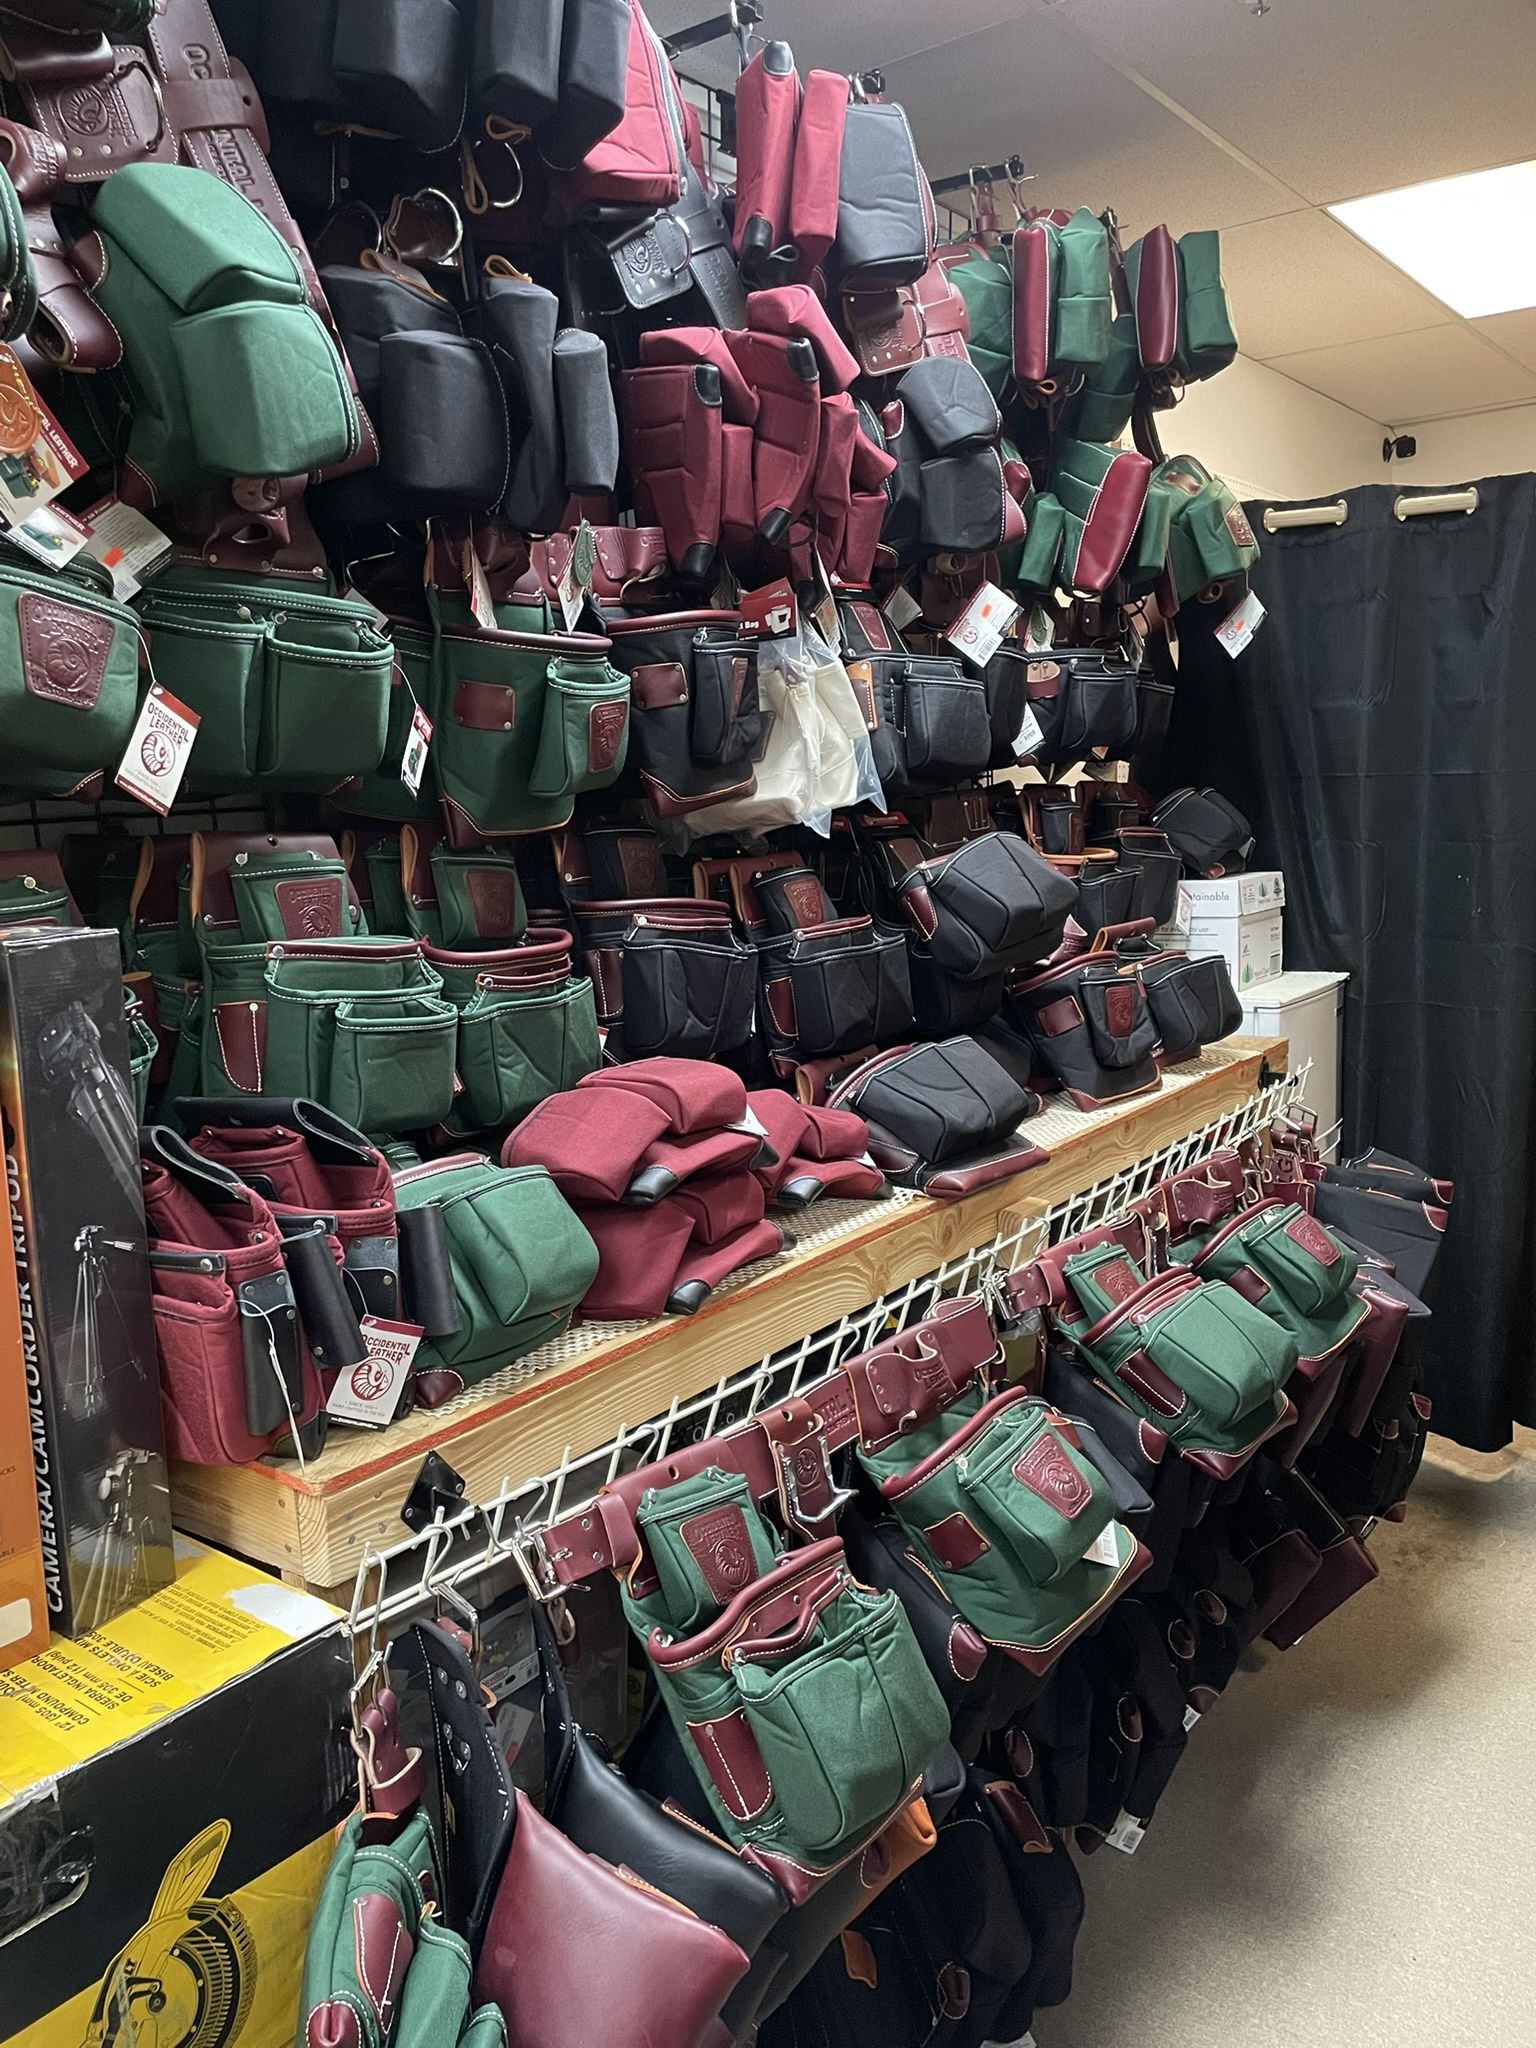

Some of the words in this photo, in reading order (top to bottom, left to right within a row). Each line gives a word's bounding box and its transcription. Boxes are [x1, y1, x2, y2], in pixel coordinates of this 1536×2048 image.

[50, 430, 79, 469] LEATHER
[148, 702, 189, 743] OCCIDENTAL
[150, 716, 182, 750] LEATHER
[369, 1347, 404, 1366] EATHER
[30, 1656, 88, 1690] INGLETADOR
[135, 1673, 162, 1688] SCIE
[140, 1662, 175, 1681] BISEAU
[37, 1692, 90, 1725] COMPOUND
[83, 1688, 120, 1710] SIERRA
[116, 1691, 133, 1703] DE
